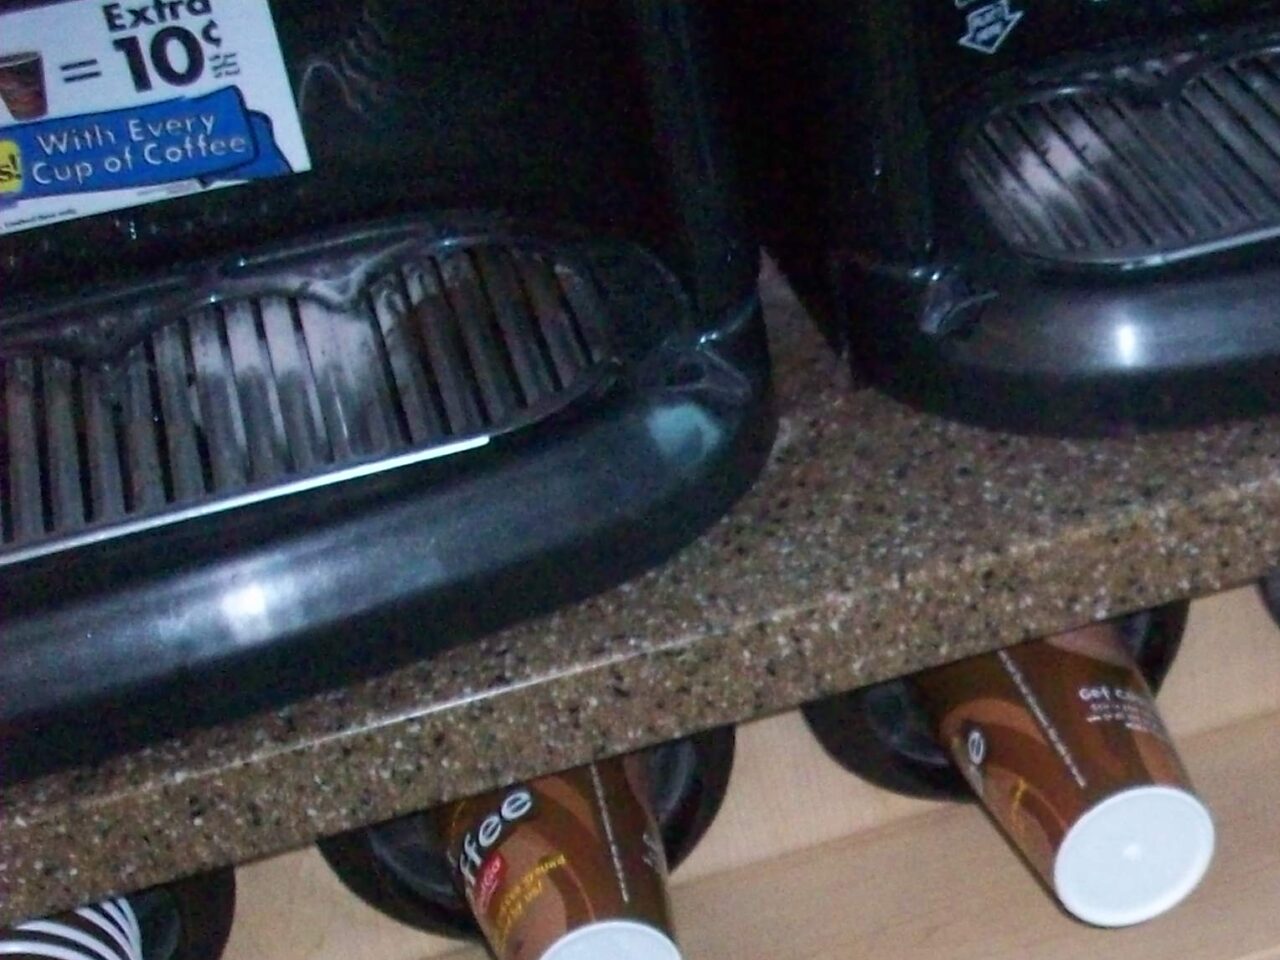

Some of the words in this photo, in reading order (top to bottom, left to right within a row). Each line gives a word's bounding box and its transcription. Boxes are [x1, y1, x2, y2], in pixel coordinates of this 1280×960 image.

[102, 0, 213, 33] Extra
[36, 123, 116, 156] With
[127, 114, 215, 142] Every
[31, 161, 93, 185] Cup
[104, 145, 133, 174] of
[143, 133, 247, 165] Coffee
